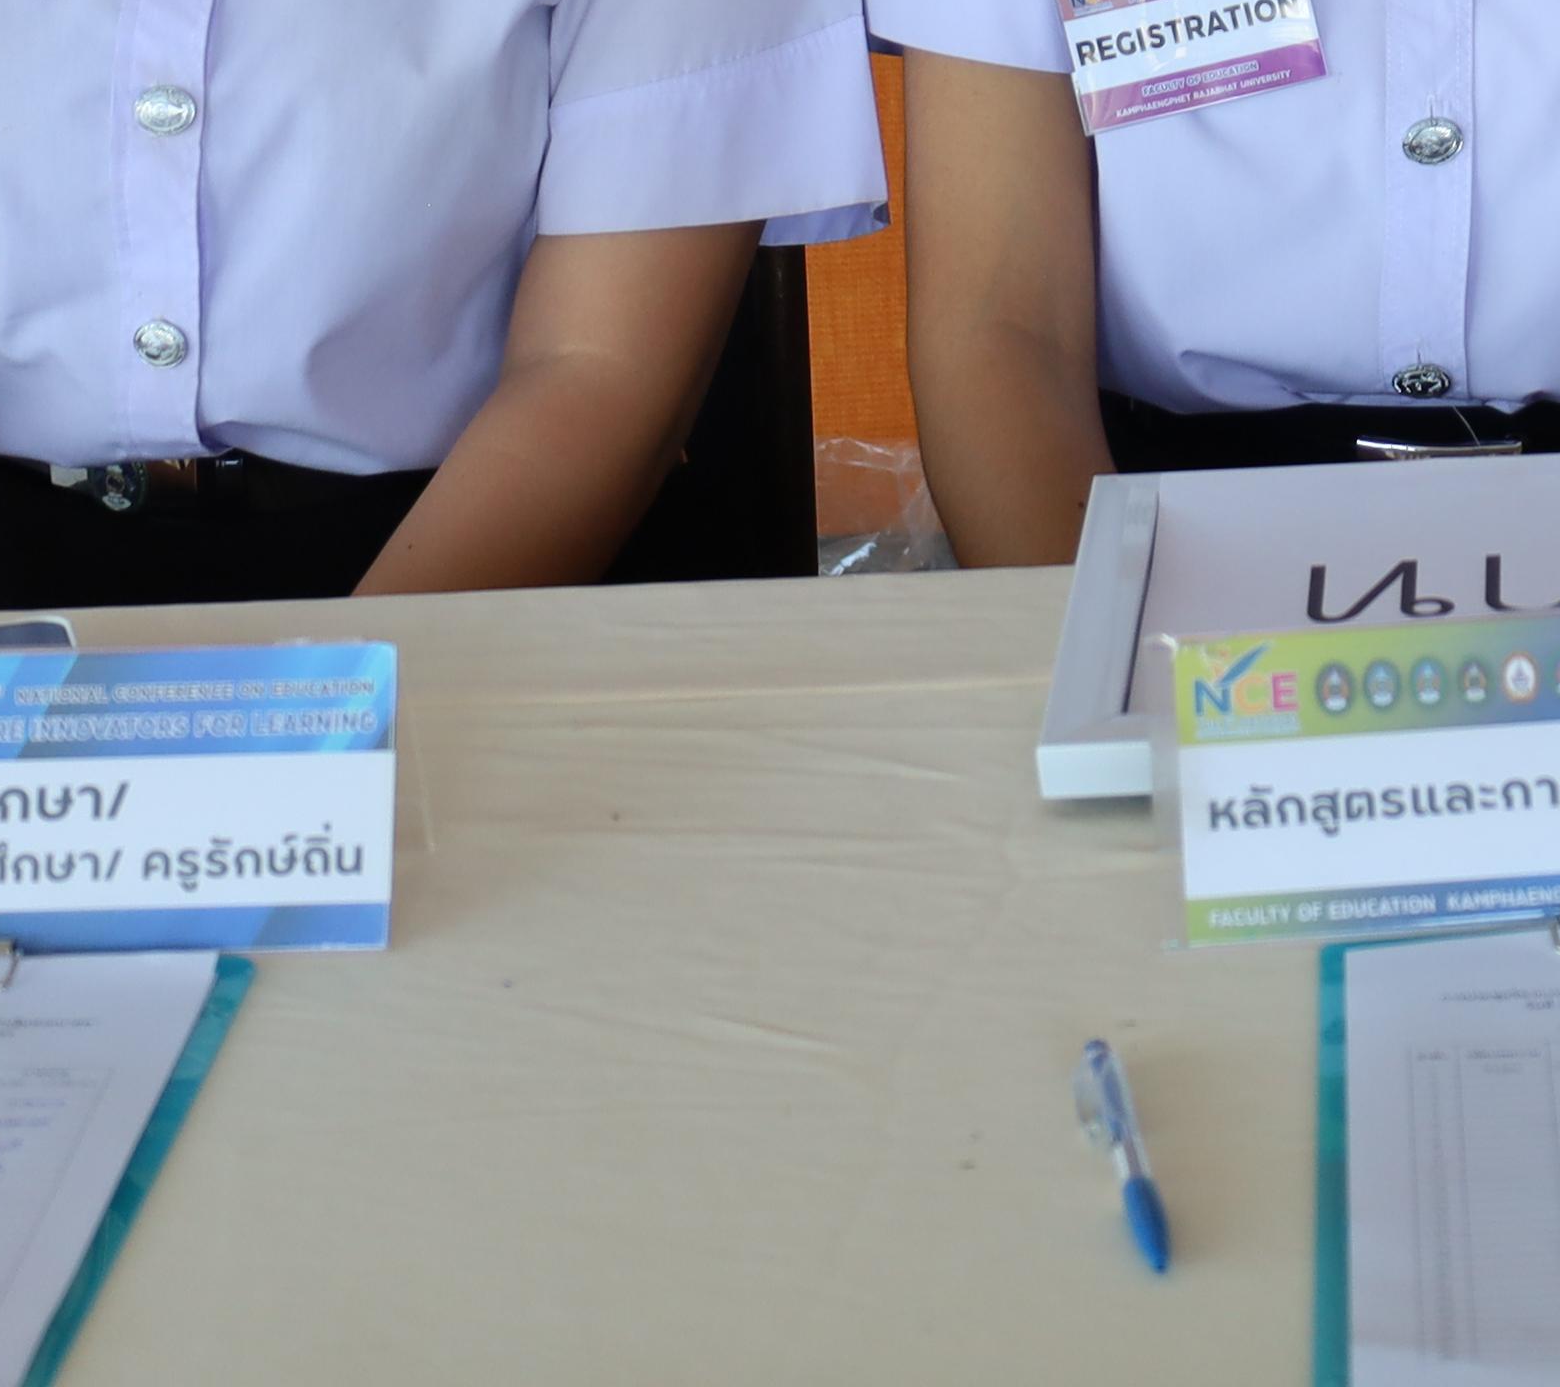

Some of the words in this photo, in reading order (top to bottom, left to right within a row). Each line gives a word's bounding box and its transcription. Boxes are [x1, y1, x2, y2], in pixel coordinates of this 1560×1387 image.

[1240, 68, 1291, 90] UNIVERSITY
[1194, 670, 1299, 717] NCE
[251, 707, 378, 736] LEARNING
[142, 819, 364, 893] ครูรักษ์ถิ่น
[1209, 905, 1292, 928] FACULTY
[1298, 902, 1323, 922] OF
[1328, 894, 1436, 919] EDUCATION
